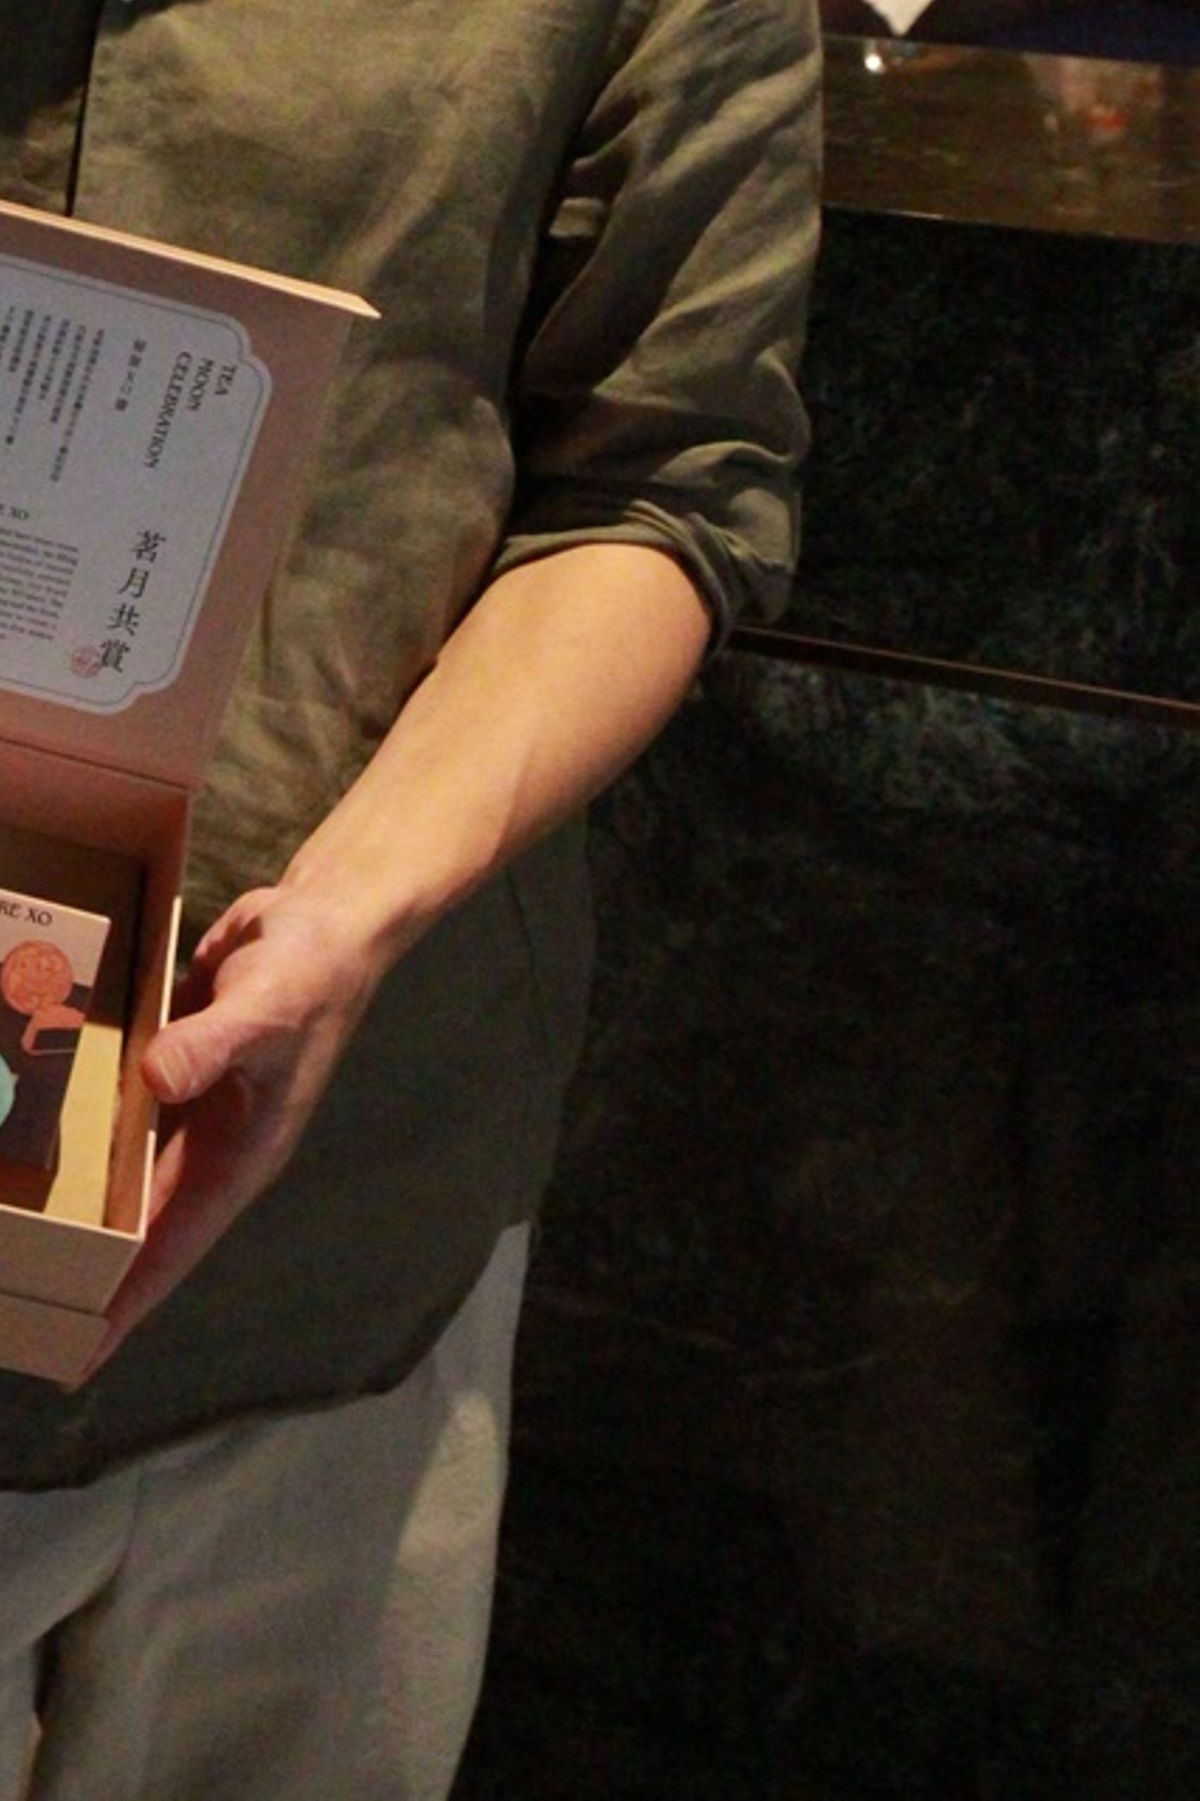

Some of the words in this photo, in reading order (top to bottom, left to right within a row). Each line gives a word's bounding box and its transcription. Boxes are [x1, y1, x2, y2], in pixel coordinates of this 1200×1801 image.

[187, 356, 215, 412] MOON
[214, 364, 238, 396] TEA
[144, 351, 193, 469] CELEBRATION
[25, 908, 53, 927] XO
